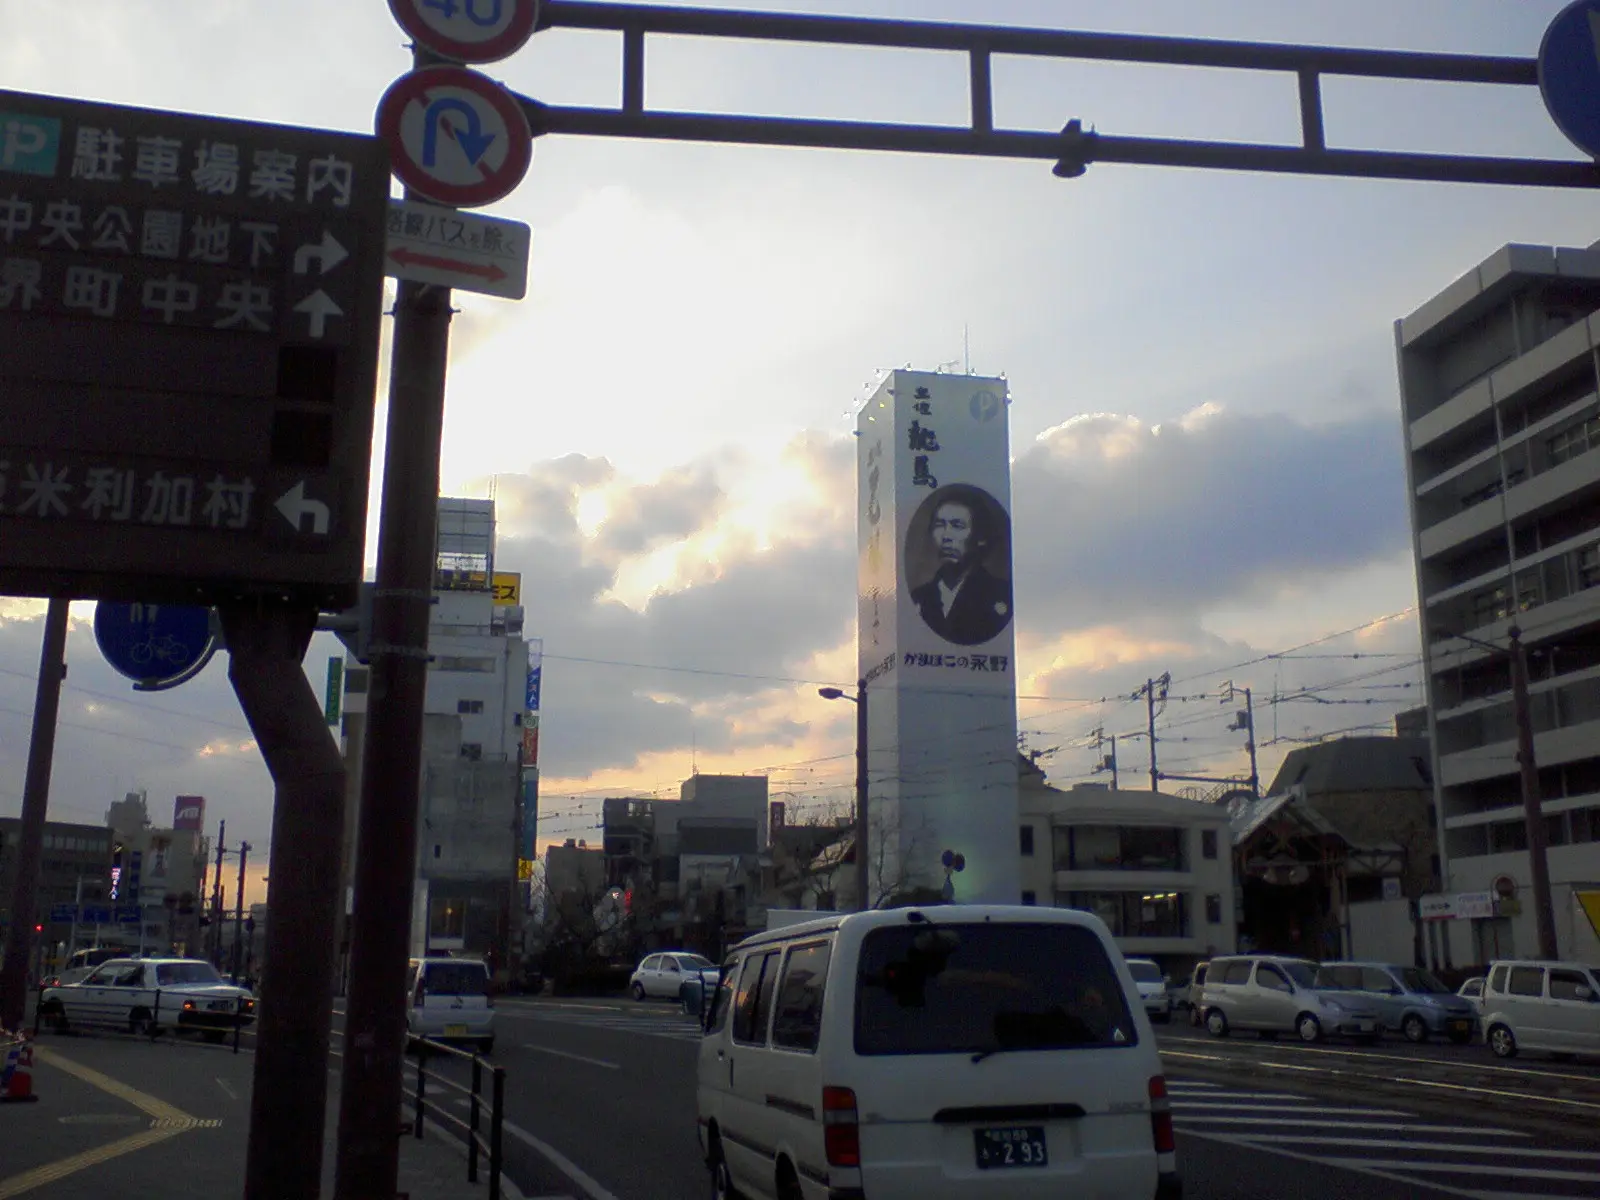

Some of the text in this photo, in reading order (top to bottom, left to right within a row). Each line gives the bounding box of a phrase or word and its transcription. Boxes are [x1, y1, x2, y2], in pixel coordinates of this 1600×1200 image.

[71, 126, 353, 207] 駐車場案内
[0, 193, 280, 268] 中央公園地下
[0, 459, 256, 529] 米利加村
